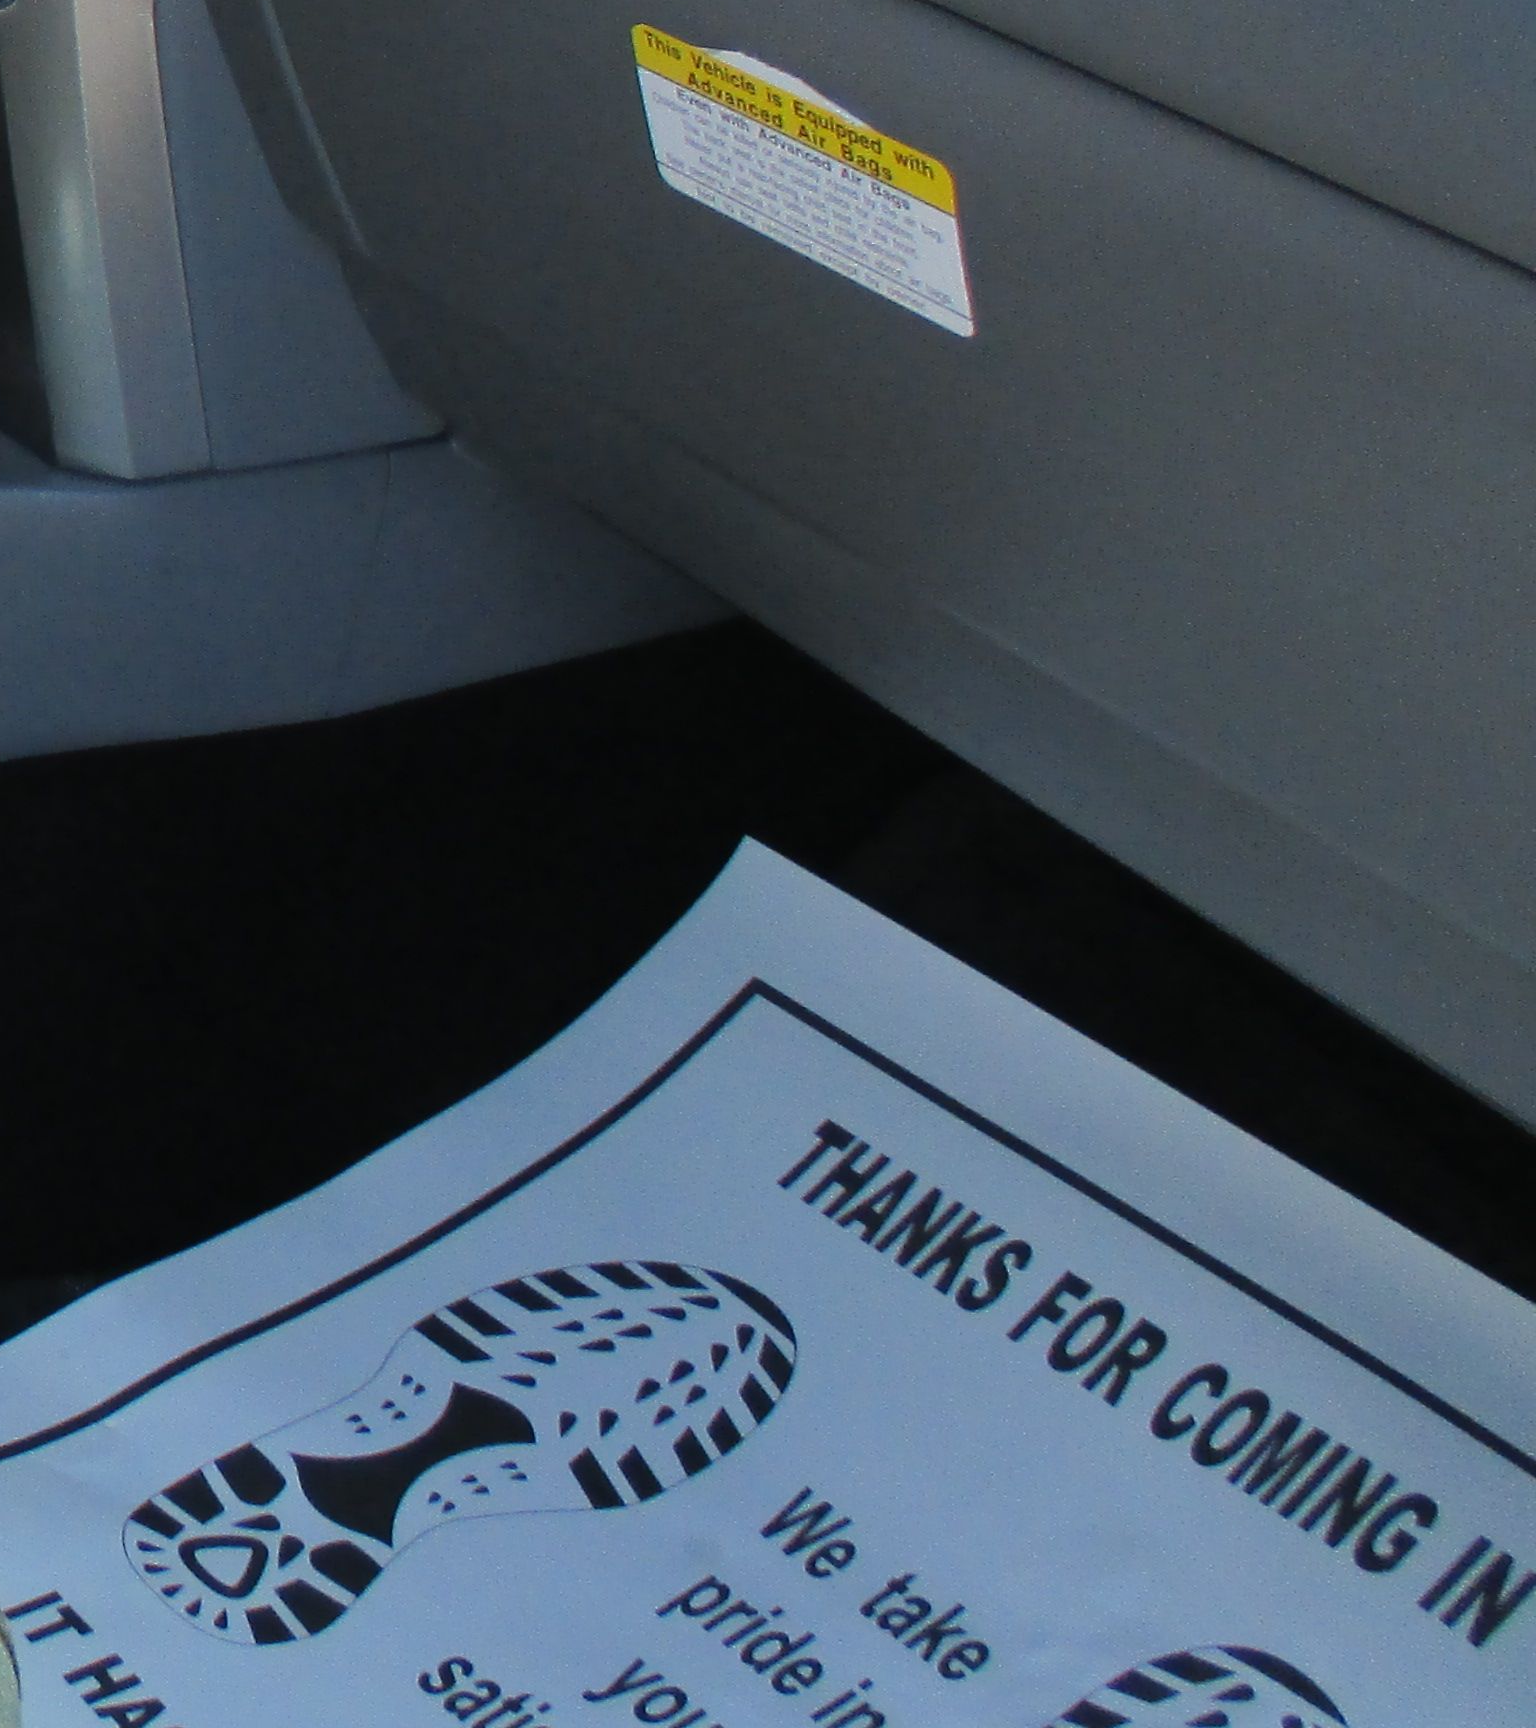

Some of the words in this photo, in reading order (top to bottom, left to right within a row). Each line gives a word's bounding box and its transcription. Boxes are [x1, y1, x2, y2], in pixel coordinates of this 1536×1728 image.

[643, 29, 682, 61] This
[690, 51, 756, 96] Vehicle
[766, 87, 783, 108] is
[792, 99, 883, 156] Equipped
[893, 150, 935, 181] with
[687, 72, 784, 129] Advanced
[797, 124, 827, 148] Air
[840, 143, 893, 182] Bags
[720, 110, 750, 132] with
[758, 127, 832, 172] Advanced
[840, 167, 862, 185] Air
[870, 181, 911, 211] Bags
[778, 1118, 1034, 1312] THANKS
[1004, 1270, 1169, 1408] FOR
[1148, 1362, 1439, 1573] COMING
[1417, 1535, 1536, 1648] IN
[3, 1589, 94, 1643] IT
[655, 1574, 825, 1696] pride
[759, 1486, 857, 1579] We
[858, 1572, 991, 1682] take
